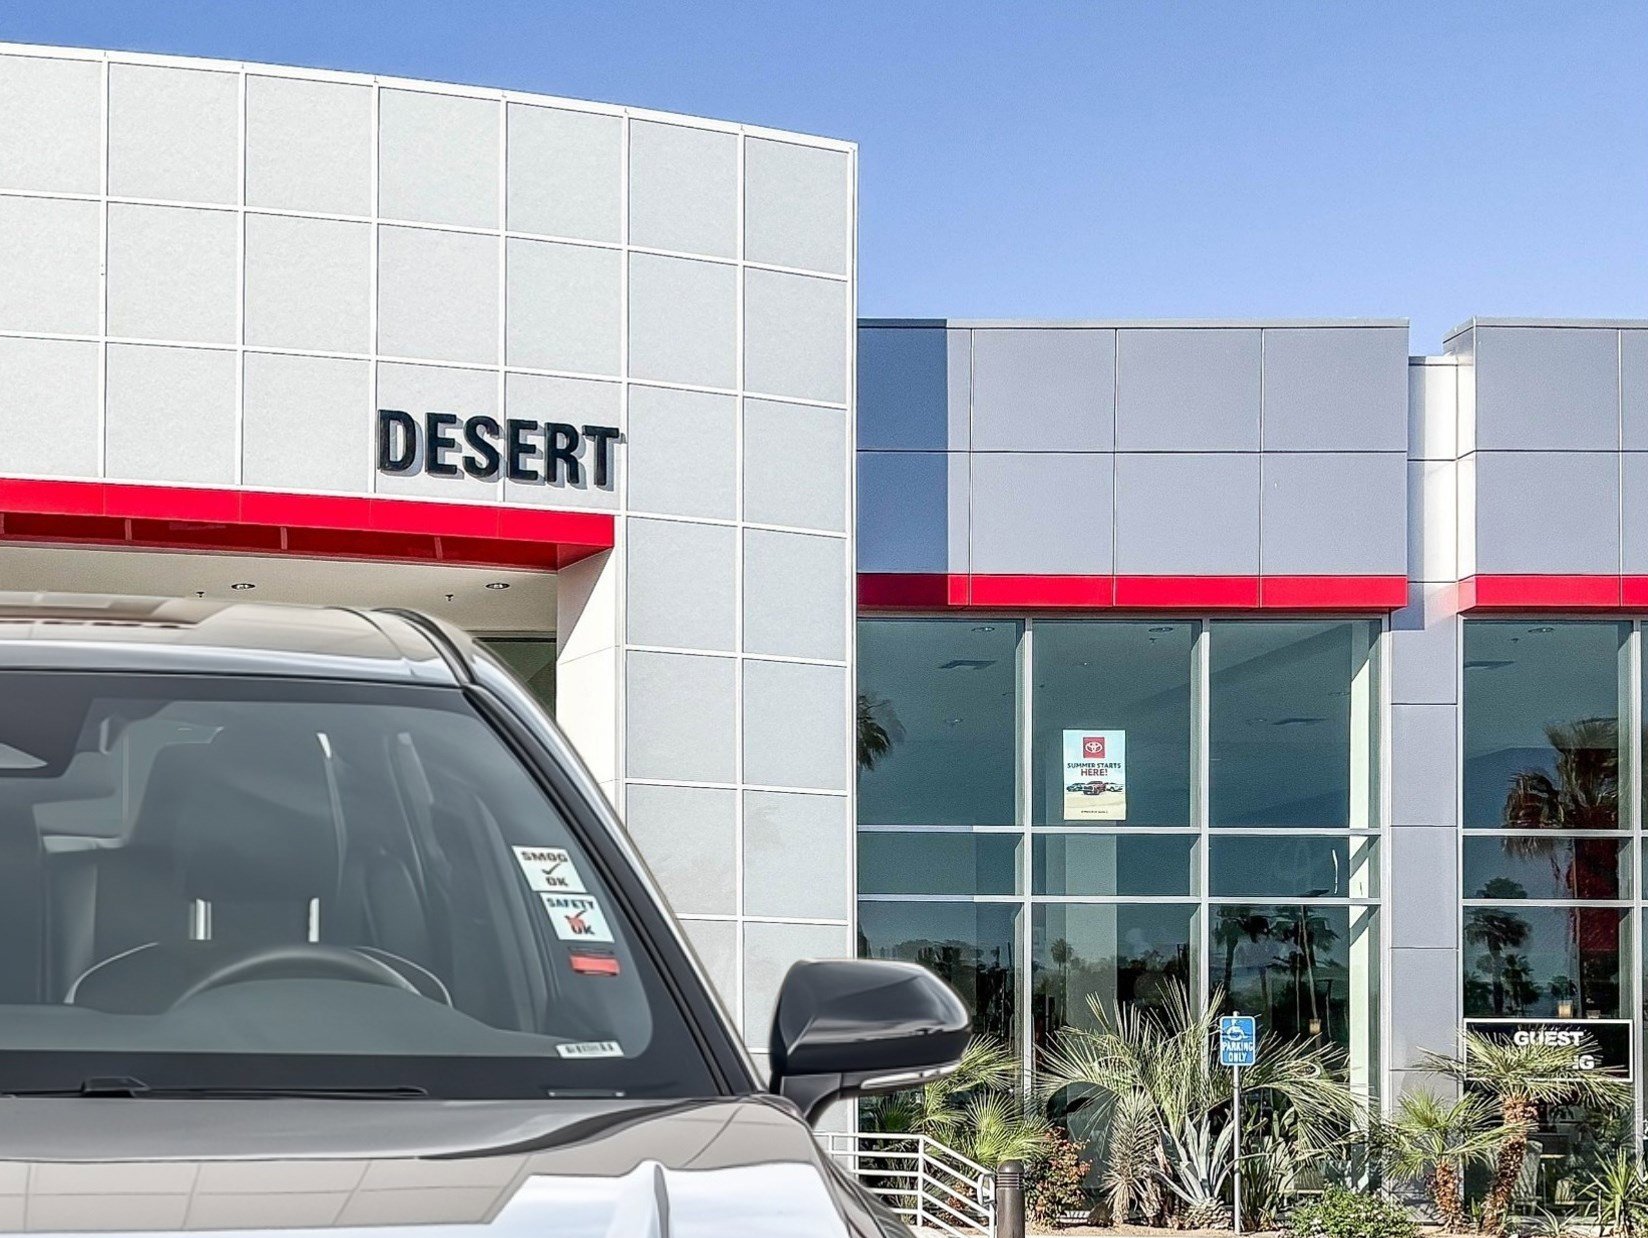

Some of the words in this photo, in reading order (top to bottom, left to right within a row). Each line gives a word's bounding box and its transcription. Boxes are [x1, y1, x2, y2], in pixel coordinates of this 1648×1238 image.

[377, 409, 620, 486] DESERT
[1080, 768, 1108, 777] HERE!
[521, 851, 569, 864] SMOG
[545, 877, 569, 888] OK
[546, 898, 595, 911] SAFETY
[1513, 1030, 1584, 1047] GUEST
[1222, 1041, 1253, 1051] PARKING
[1228, 1052, 1247, 1062] ONLY
